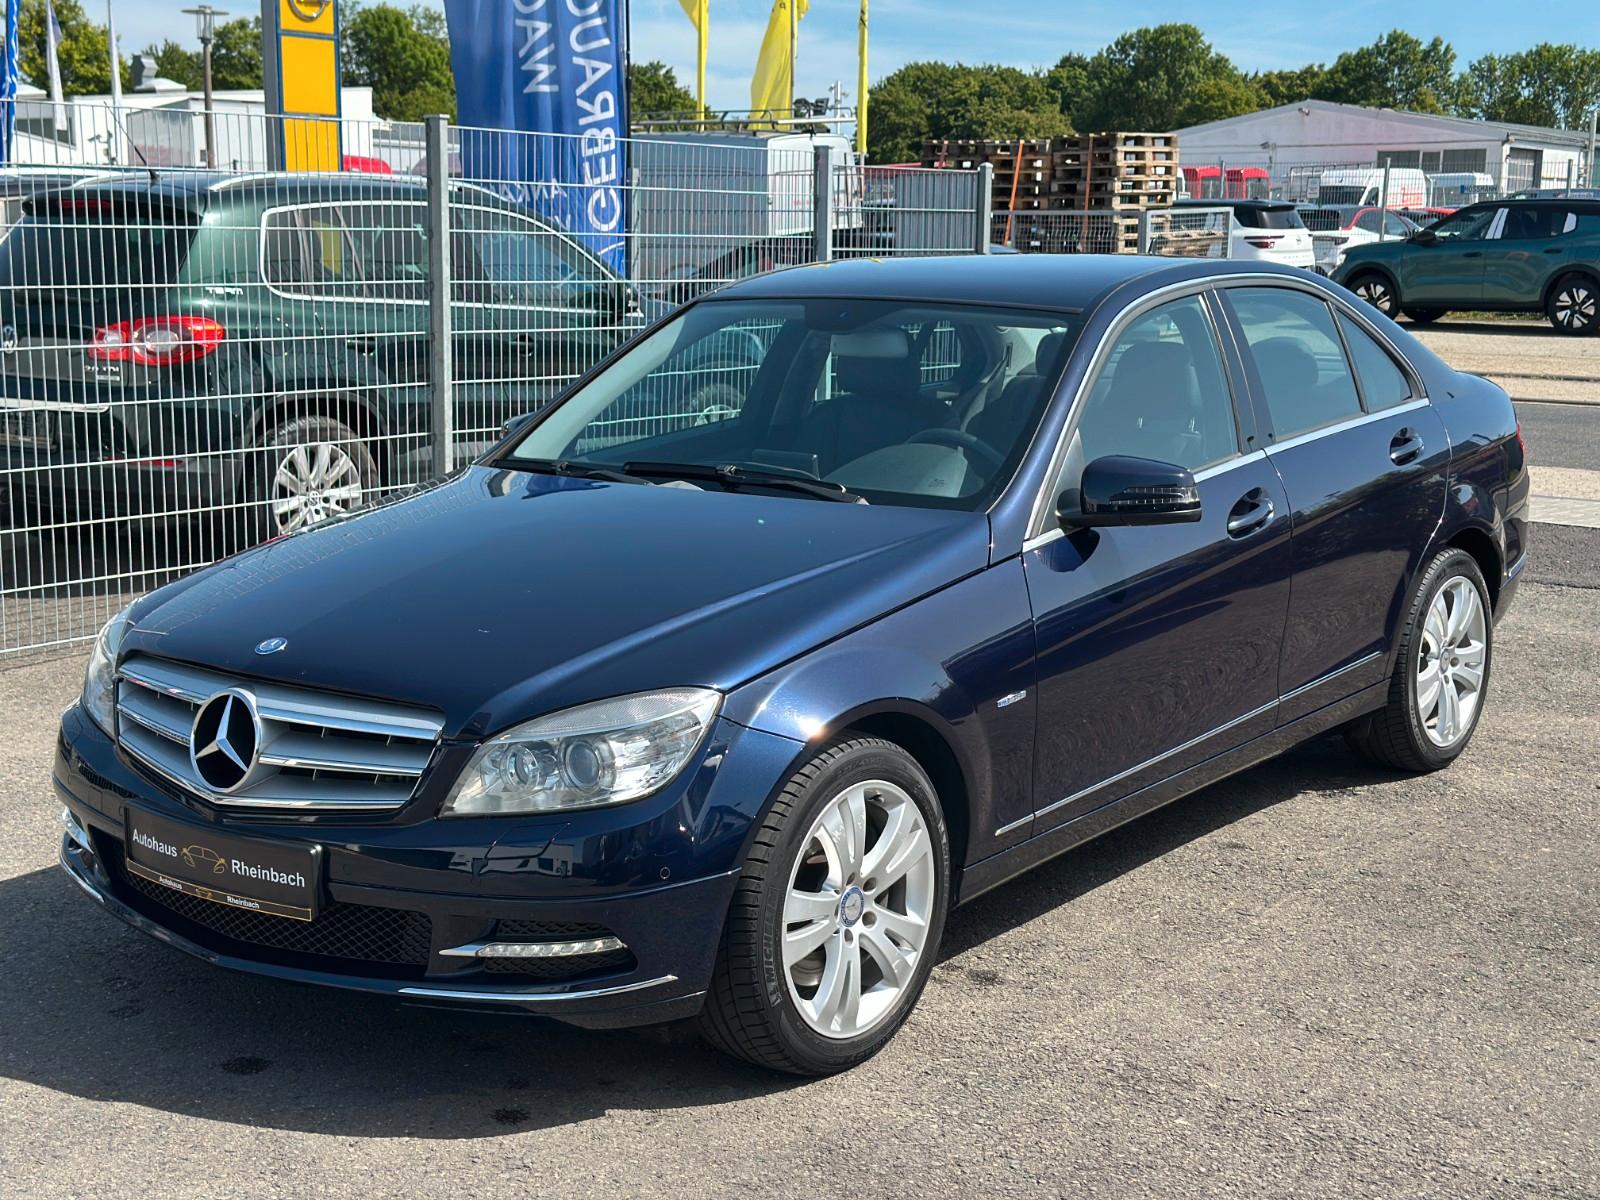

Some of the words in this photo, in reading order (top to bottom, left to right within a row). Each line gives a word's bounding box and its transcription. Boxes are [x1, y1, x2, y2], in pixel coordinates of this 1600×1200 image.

[132, 828, 178, 857] Autohaus
[231, 859, 305, 888] Rheinbach
[226, 895, 260, 910] Rheinbach
